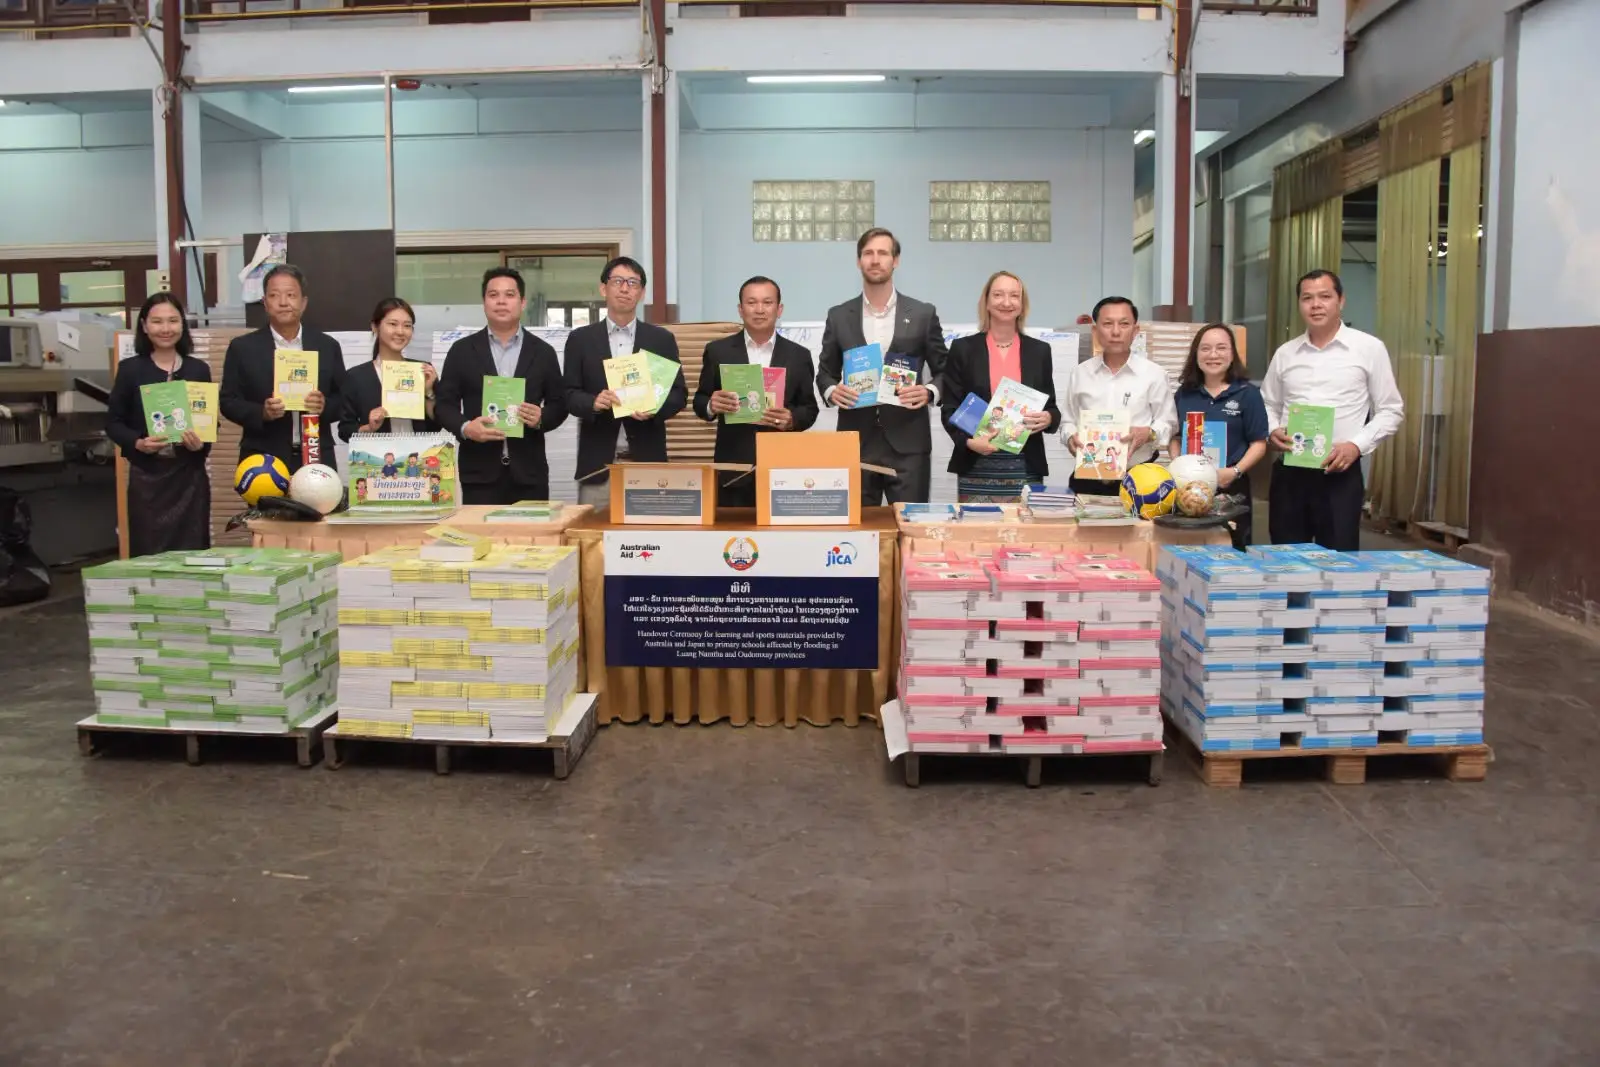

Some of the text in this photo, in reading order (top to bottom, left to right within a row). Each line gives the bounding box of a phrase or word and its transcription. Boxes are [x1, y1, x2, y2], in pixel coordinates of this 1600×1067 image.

[308, 437, 319, 464] TAR
[619, 543, 661, 551] Australian
[620, 551, 634, 559] Aid
[730, 581, 751, 594] ພິທີ
[637, 629, 668, 637] Handover
[669, 630, 702, 639] Ceremony
[704, 630, 713, 638] for
[715, 631, 741, 639] learning
[742, 631, 755, 639] and
[755, 632, 775, 640] sports
[806, 632, 836, 641] provided
[836, 632, 845, 640] by
[644, 639, 673, 647] Australia
[687, 640, 705, 649] Japan
[714, 641, 740, 650] primary
[741, 641, 765, 649] schools
[766, 641, 792, 649] affected
[793, 641, 802, 650] by
[803, 641, 830, 651] flooding
[676, 650, 697, 659] Luang
[698, 650, 723, 658] Namtha
[737, 651, 773, 660] Oudomxay
[774, 651, 806, 660] provinces
